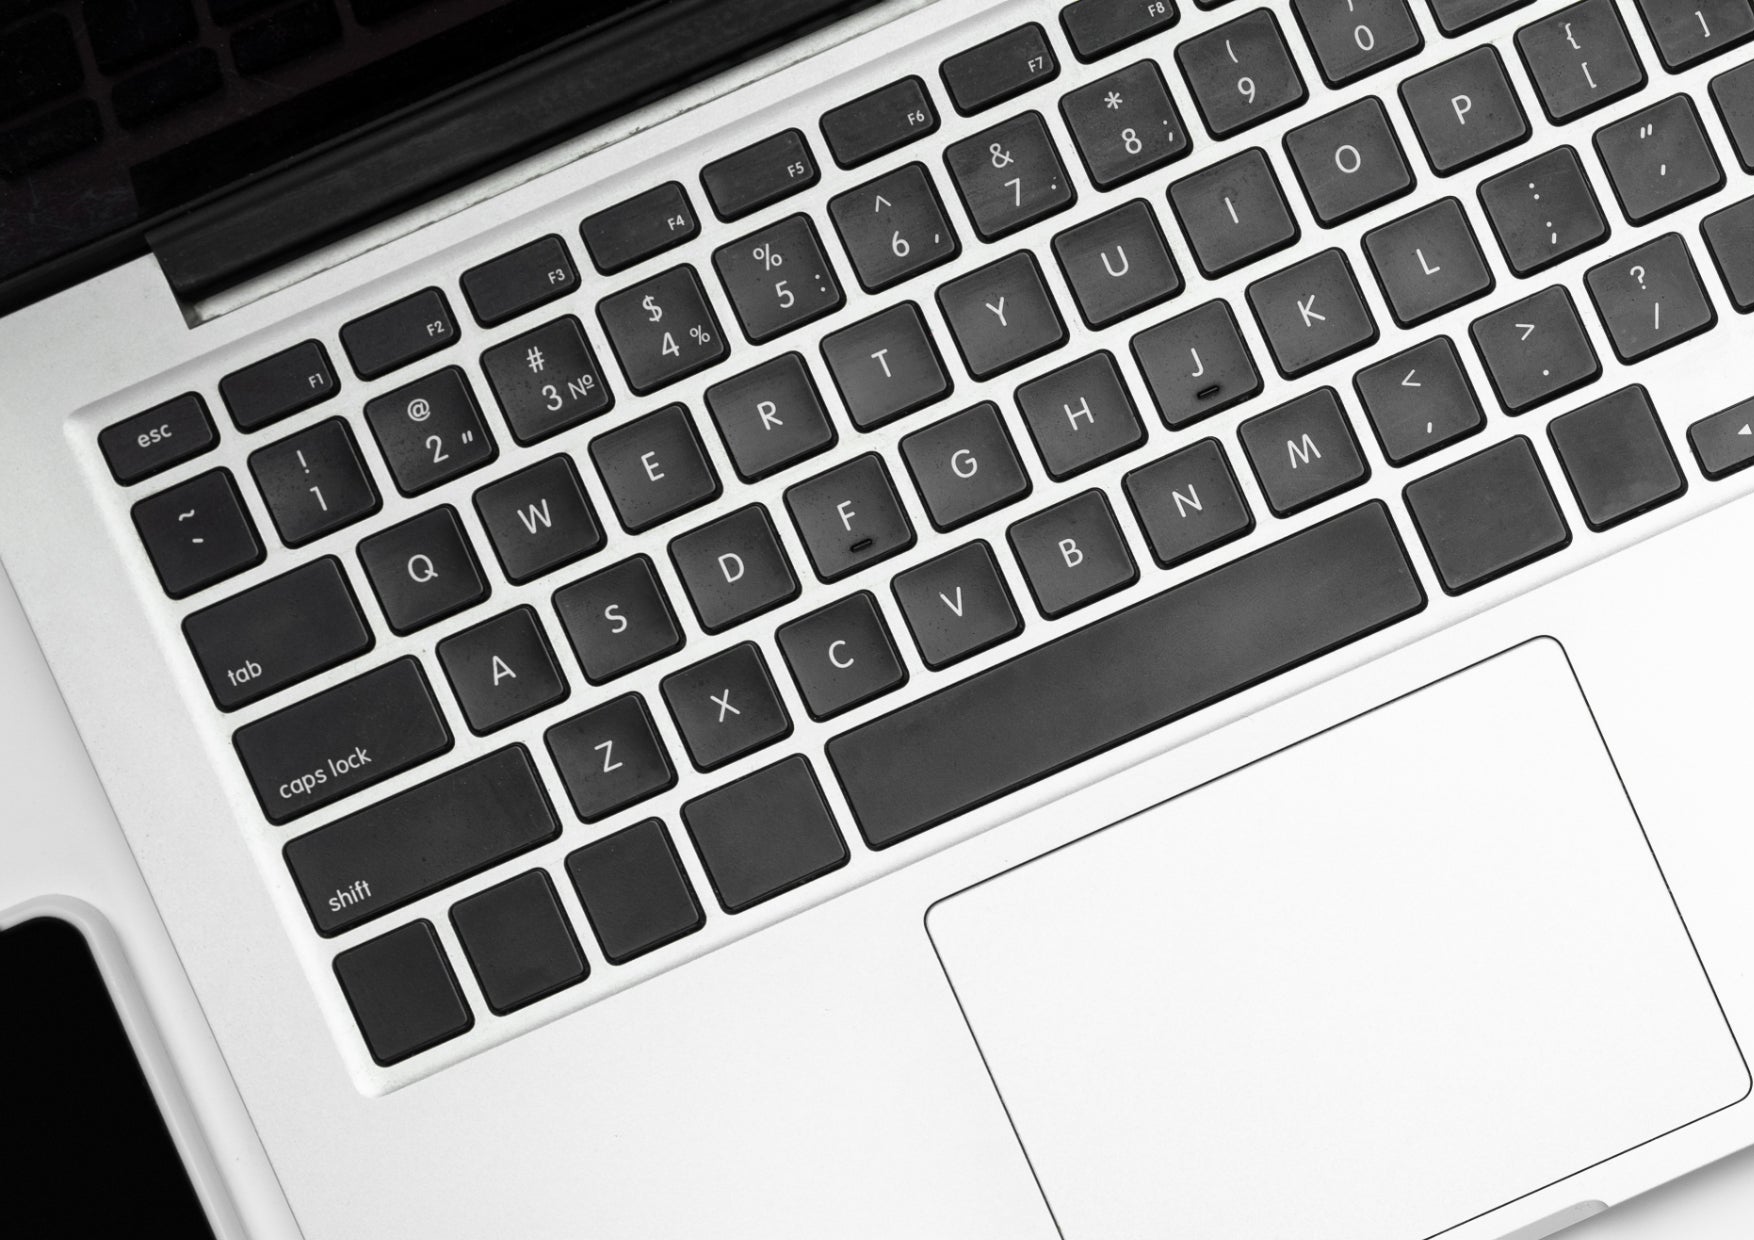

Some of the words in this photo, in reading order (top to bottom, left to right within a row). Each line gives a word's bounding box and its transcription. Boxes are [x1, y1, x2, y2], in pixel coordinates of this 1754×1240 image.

[1147, 1, 1166, 18] F8
[1354, 24, 1375, 51] 0
[1564, 22, 1581, 50] {
[1694, 10, 1711, 38] ]
[1027, 56, 1043, 73] F7
[1225, 39, 1239, 64] (
[1581, 61, 1597, 89] [
[1237, 76, 1256, 104] 9
[907, 109, 925, 126] F6
[1451, 94, 1472, 125] P
[1121, 127, 1143, 155] 8
[787, 161, 805, 178] F5
[989, 142, 1014, 169] &
[1334, 144, 1361, 174] O
[875, 195, 892, 213] ^
[1004, 177, 1021, 207] 7
[667, 214, 685, 231] F4
[1224, 197, 1240, 224] I
[752, 243, 783, 271] %
[891, 230, 910, 258] 6
[1100, 245, 1129, 277] U
[1416, 248, 1441, 276] L
[547, 268, 566, 285] F3
[1629, 265, 1647, 290] ?
[642, 294, 663, 322] $
[775, 280, 795, 309] 5
[985, 296, 1008, 327] Y
[1297, 294, 1326, 328] K
[426, 320, 445, 337] F2
[661, 331, 680, 357] 4
[689, 324, 711, 346] %
[1515, 323, 1535, 341] >
[526, 346, 545, 374] #
[870, 348, 892, 378] T
[1190, 347, 1204, 378] J
[308, 372, 324, 389] F1
[1401, 369, 1422, 387] <
[407, 398, 431, 422] @
[541, 384, 563, 411] 3
[756, 400, 784, 431] R
[1063, 396, 1095, 431] H
[137, 423, 173, 448] esc
[425, 434, 449, 464] 2
[296, 449, 310, 474] !
[950, 448, 978, 479] G
[1287, 433, 1322, 469] M
[640, 451, 665, 482] E
[309, 485, 328, 511] 1
[1171, 483, 1203, 518] N
[516, 498, 552, 535] W
[836, 500, 856, 532] F
[1058, 538, 1084, 568] B
[407, 554, 439, 583] Q
[717, 552, 745, 583] D
[939, 586, 963, 617] V
[604, 604, 628, 634] S
[828, 639, 855, 669] C
[227, 660, 262, 687] tab
[492, 655, 517, 686] A
[709, 688, 741, 723] X
[594, 740, 623, 773] Z
[279, 768, 328, 800] caps
[327, 746, 373, 778] lock
[328, 880, 372, 912] shift
